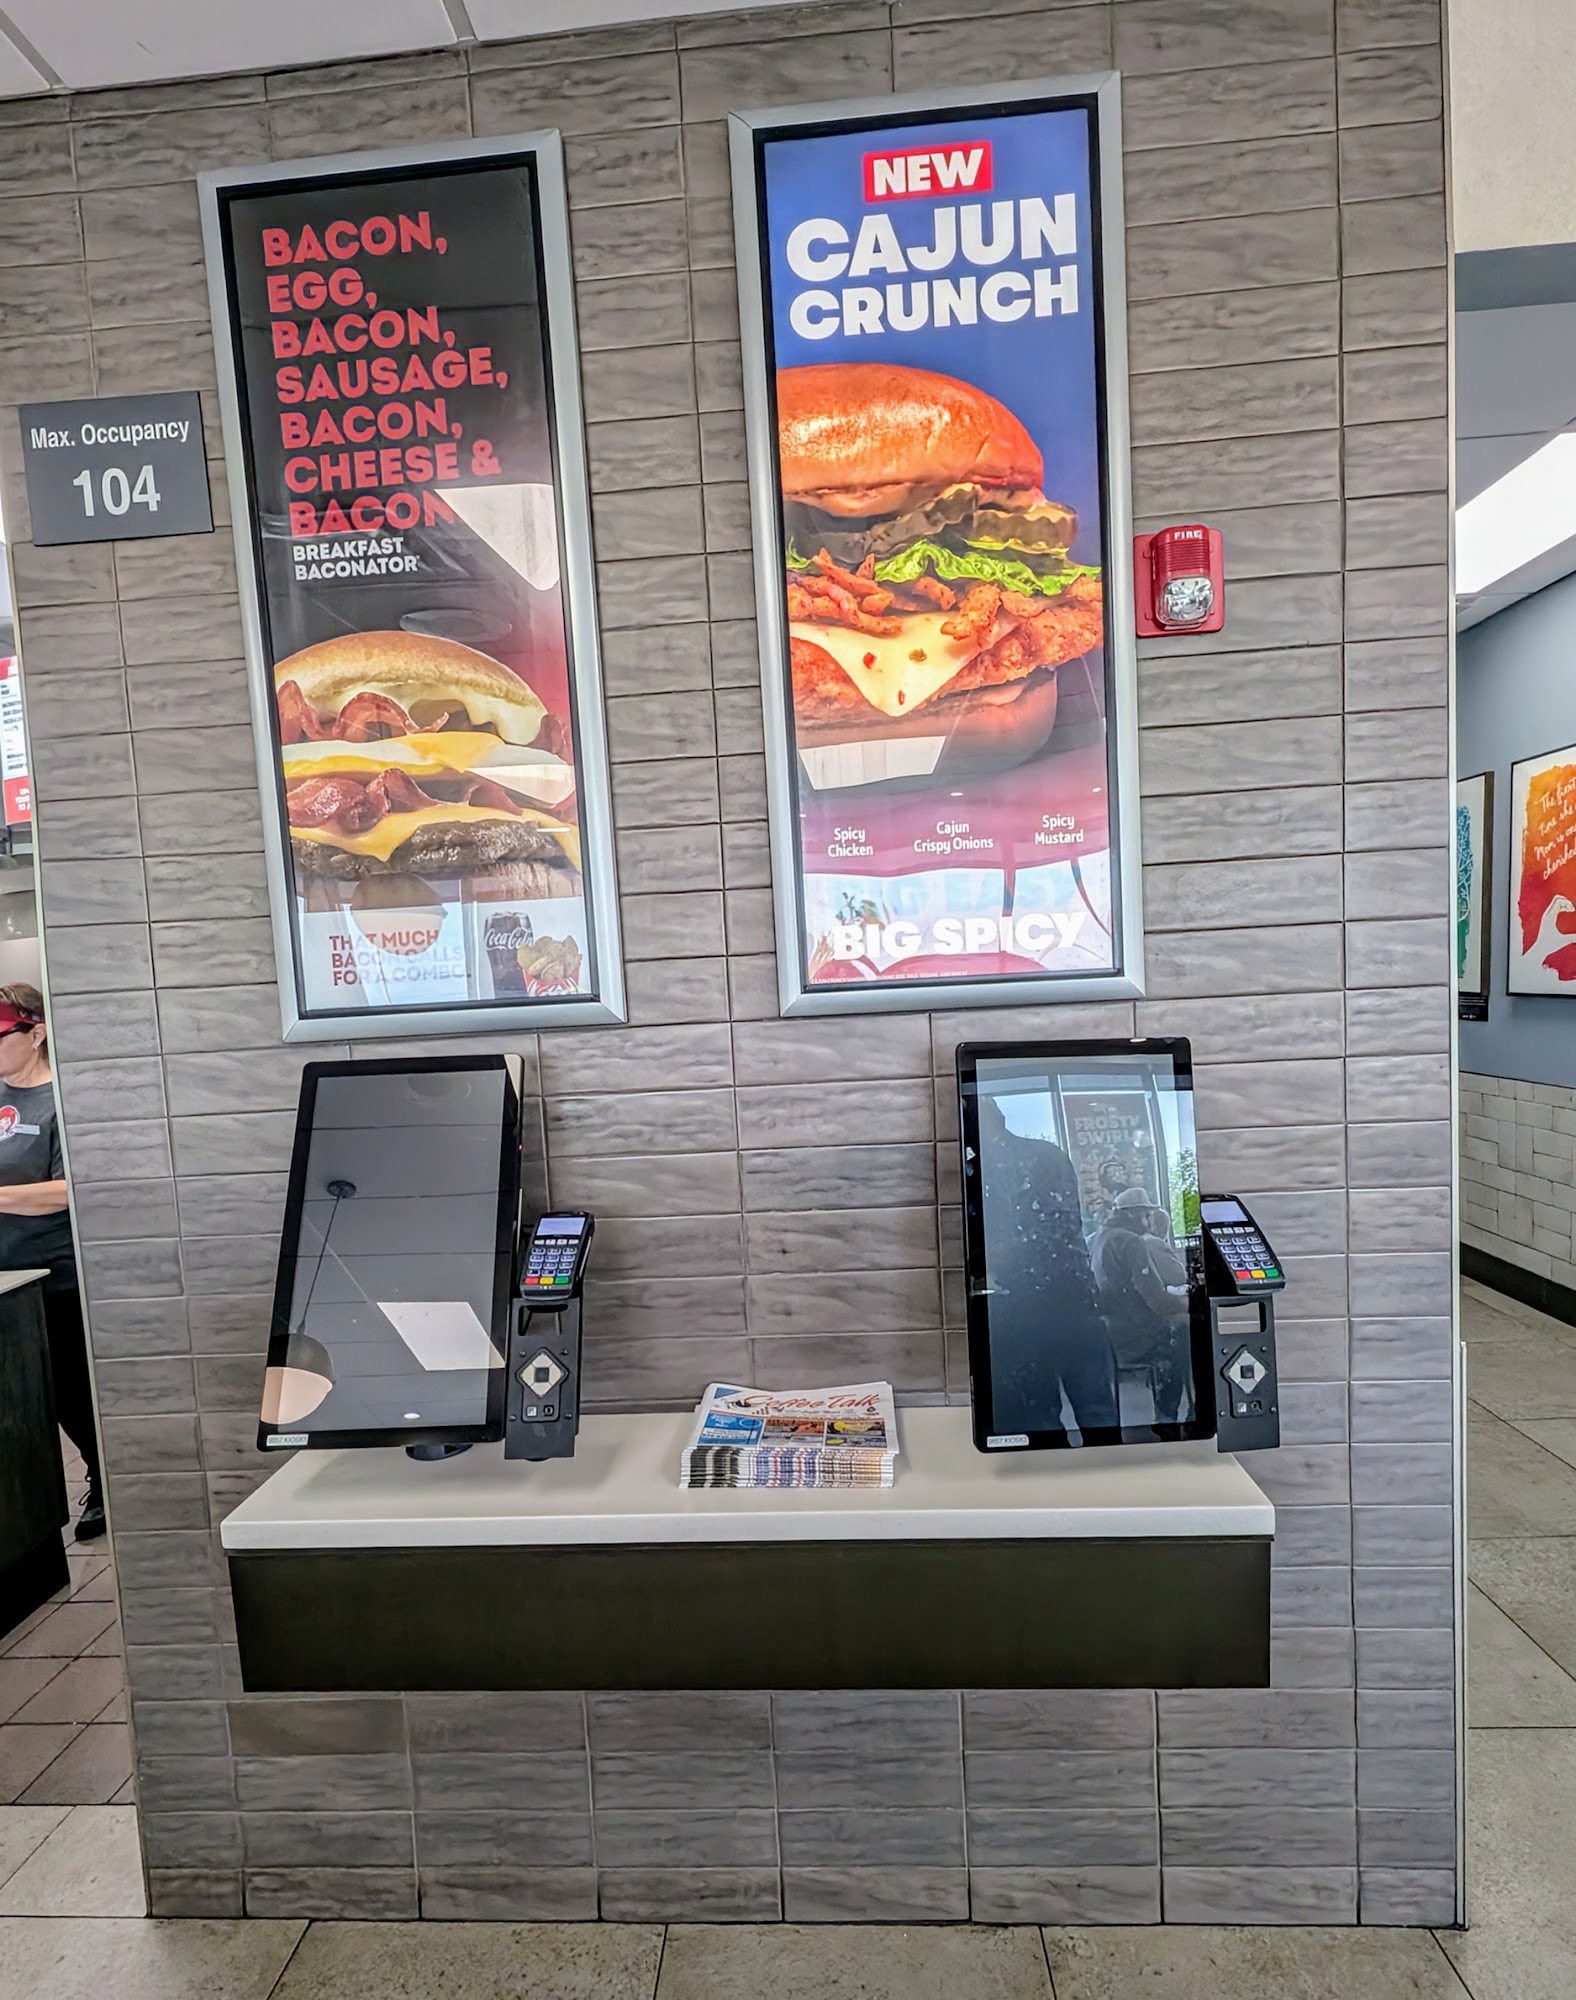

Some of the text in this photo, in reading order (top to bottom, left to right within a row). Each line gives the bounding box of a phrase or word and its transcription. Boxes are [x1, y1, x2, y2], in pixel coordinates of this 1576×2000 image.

[873, 148, 984, 196] NEW
[262, 211, 448, 267] BACON,
[786, 193, 1077, 282] CAJUN
[267, 267, 377, 313] EGG,
[789, 264, 1078, 340] CRUNCH
[271, 306, 456, 359] BACON,
[276, 347, 508, 404] SAUSAGE,
[31, 421, 189, 449] Max. Occupancy
[280, 398, 463, 449] BACON,
[284, 439, 502, 494] CHEESE &
[73, 464, 161, 517] 104
[289, 490, 455, 538] BACON
[293, 537, 404, 561] BREAKFAST
[1174, 530, 1202, 540] FIRE
[834, 827, 866, 842] Spicy
[936, 821, 970, 837] Cajun
[1042, 815, 1075, 830] Spicy
[828, 844, 873, 857] Chicken
[914, 836, 994, 855] Crispy Onions
[1035, 829, 1084, 845] Mustard
[329, 929, 439, 952] THAT MUCH
[832, 911, 1087, 960] BIG SPICY
[332, 944, 464, 970] BACON CALLS
[333, 968, 370, 986] FOR
[828, 1393, 881, 1409] Talk
